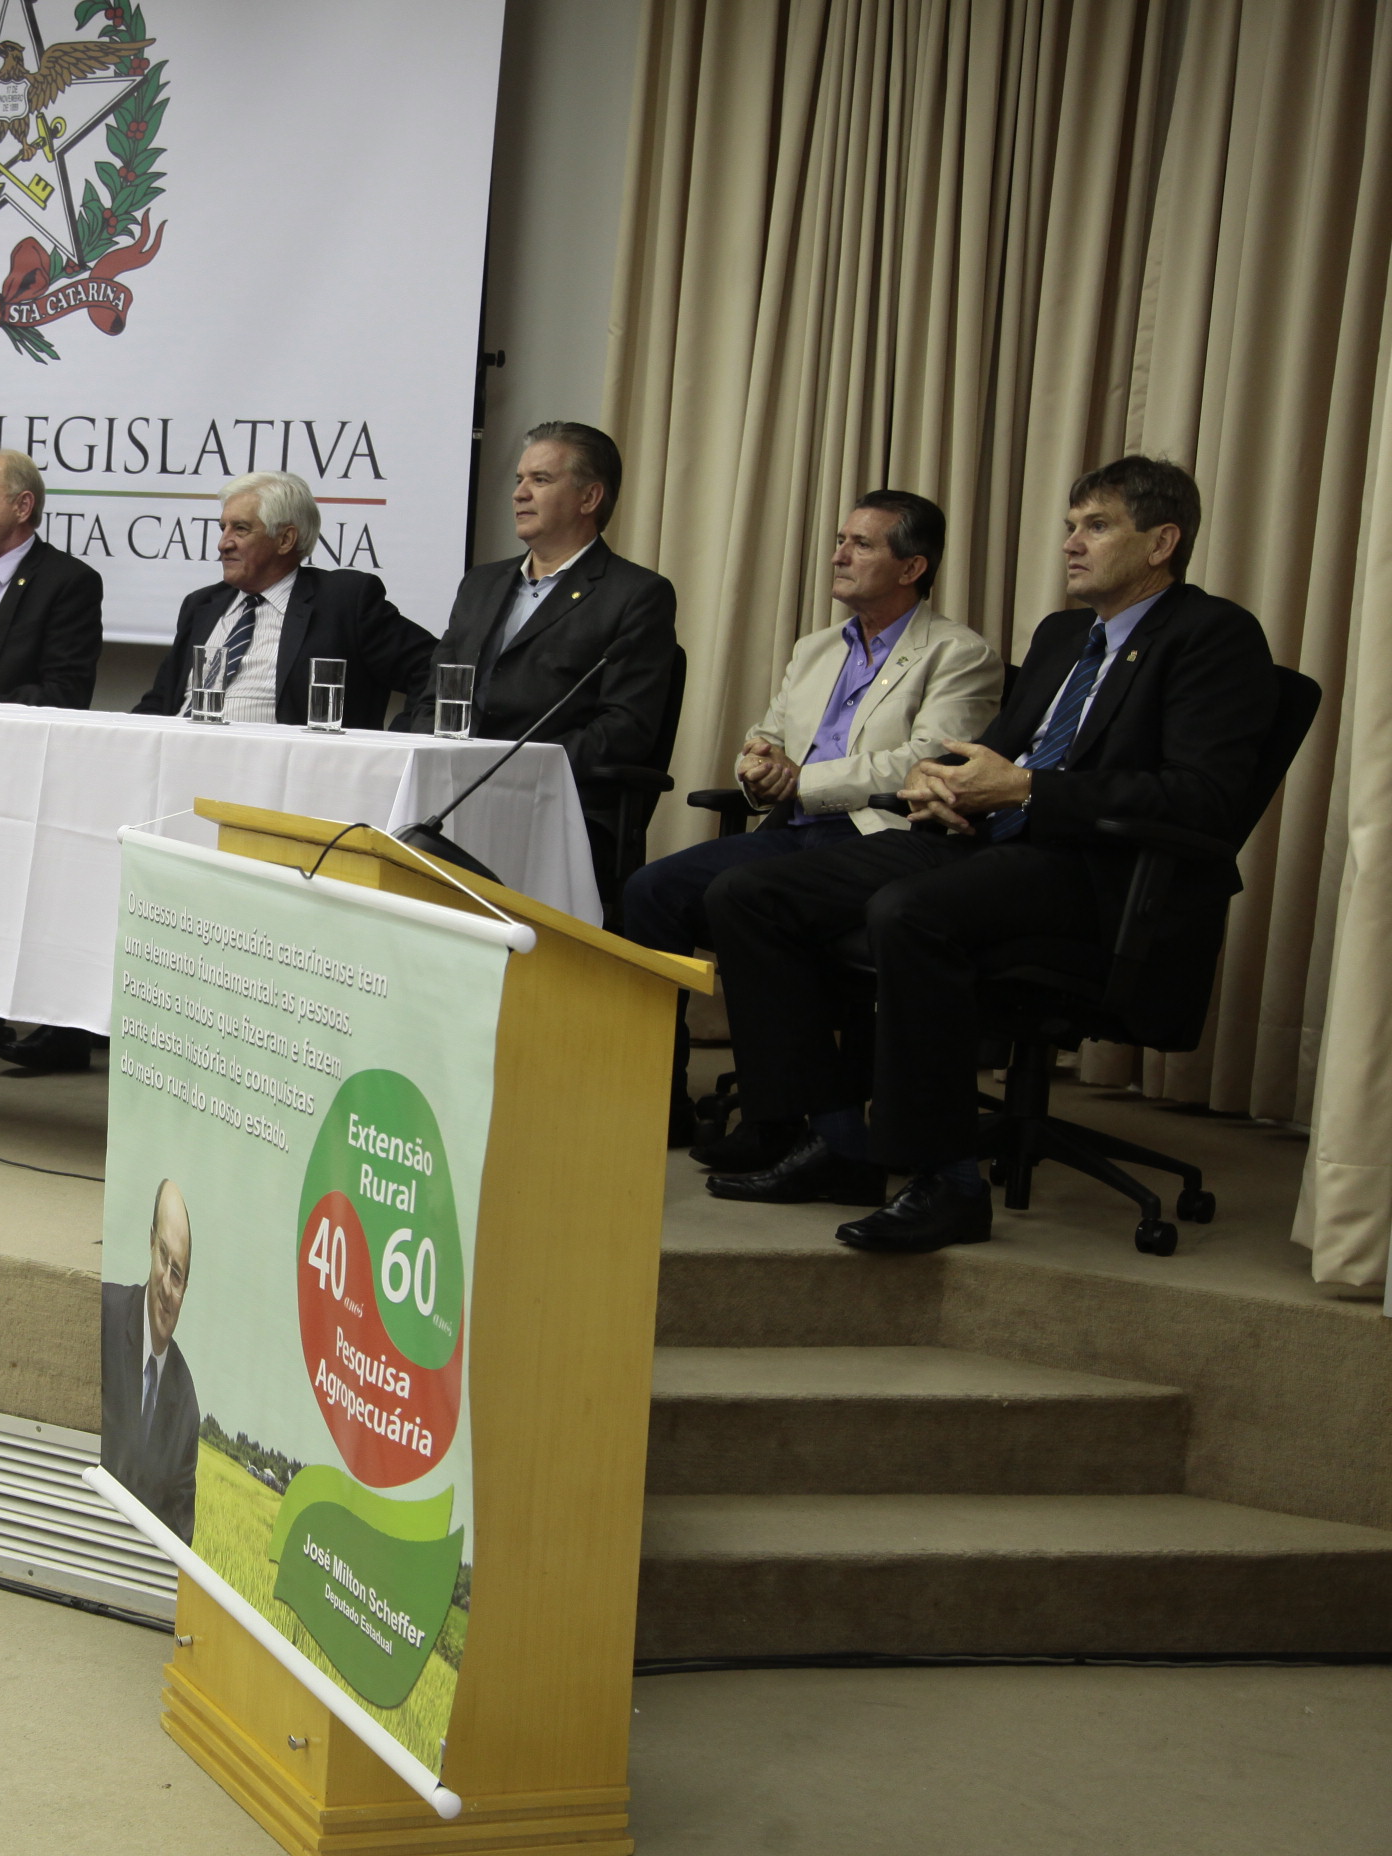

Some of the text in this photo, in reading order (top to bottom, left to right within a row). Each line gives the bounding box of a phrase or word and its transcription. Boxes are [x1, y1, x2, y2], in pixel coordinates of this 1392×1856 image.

[9, 304, 45, 323] STA.
[47, 282, 126, 315] CATARINA
[127, 514, 383, 569] CATNA
[124, 935, 352, 1036] um elemento fundamental: as pessoas.
[128, 890, 388, 998] O sucesso da agropecuária catarinense tem
[121, 1015, 314, 1115] parte desta história de conquistas
[123, 970, 342, 1081] Parabéns a todos que fizeram e fazem
[120, 1049, 289, 1152] do meio rural do nosso estado.
[348, 1113, 432, 1176] Extensão
[359, 1163, 416, 1214] Rural
[308, 1217, 363, 1318] 40 anos
[381, 1228, 452, 1336] 60 anos
[315, 1358, 432, 1457] Agropecuária
[336, 1325, 410, 1399] Pesquisa
[303, 1533, 426, 1649] José Milton Scheffer
[325, 1583, 393, 1656] Deputado Estadual
